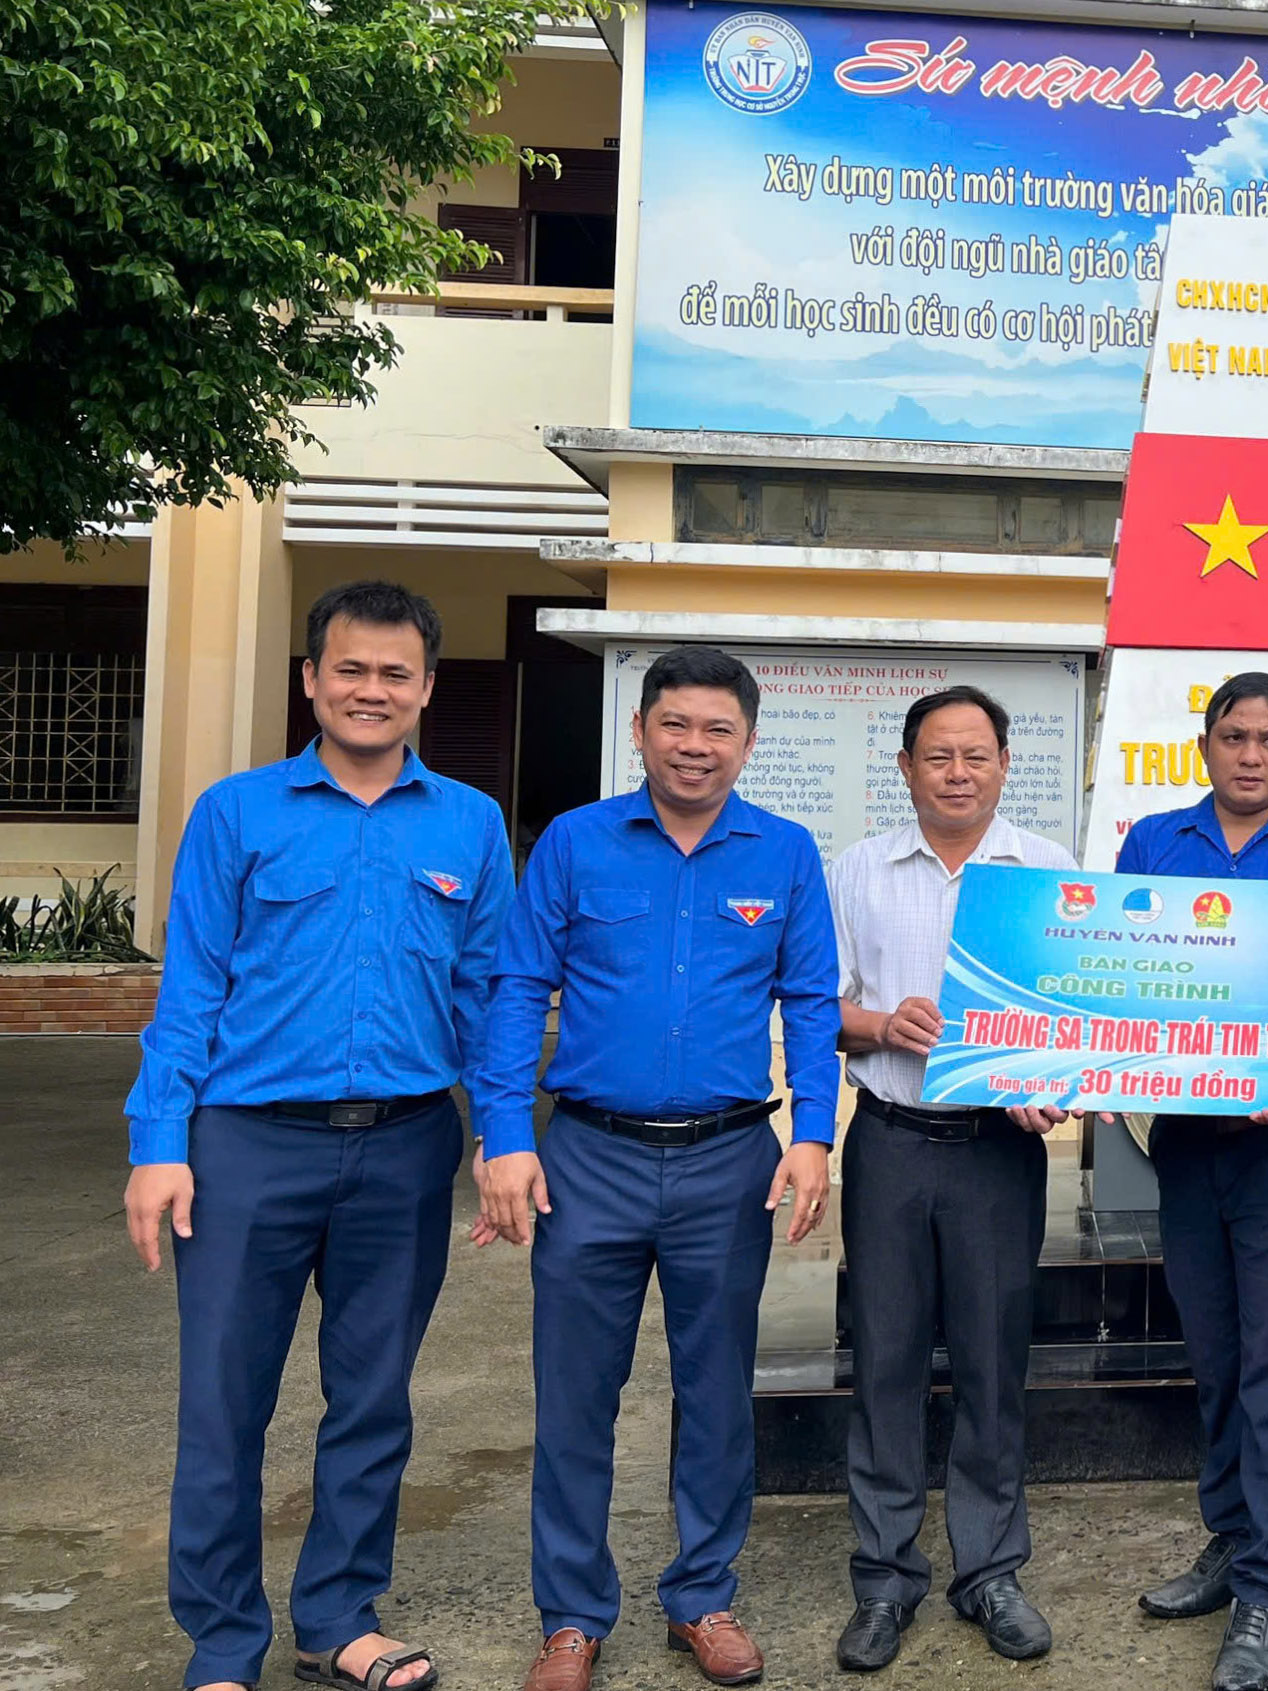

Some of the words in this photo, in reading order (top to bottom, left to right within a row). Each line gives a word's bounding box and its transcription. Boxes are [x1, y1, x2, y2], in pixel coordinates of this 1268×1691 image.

[745, 15, 760, 24] DÂN
[980, 50, 1164, 108] mệnh
[764, 154, 816, 202] Xây
[822, 156, 894, 206] dựng
[900, 163, 958, 216] một
[962, 165, 1015, 206] môi
[1021, 170, 1114, 218] trường
[1120, 180, 1168, 214] văn
[1174, 177, 1226, 216] hóa
[850, 227, 894, 266] với
[900, 228, 946, 272] đội
[951, 238, 1004, 277] ngũ
[1010, 237, 1061, 277] nhà
[1069, 239, 1128, 285] giáo
[1133, 242, 1163, 281] tâ
[680, 281, 717, 328] để
[722, 283, 777, 330] mỗi
[784, 291, 836, 339] học
[839, 294, 899, 336] sinh
[906, 294, 959, 338] đều
[965, 304, 997, 341] có
[1003, 308, 1035, 342] cơ
[1040, 302, 1084, 353] hội
[1090, 304, 1154, 353] phát
[1167, 337, 1220, 380] VIỆT
[756, 665, 770, 676] 10
[813, 663, 844, 677] VĂN
[849, 667, 886, 679] MINH
[891, 668, 925, 682] LỊCH
[928, 668, 949, 682] SỰ
[788, 684, 824, 695] GIAO
[828, 680, 862, 696] TIẾP
[866, 681, 896, 696] CỦA
[1036, 727, 1064, 739] đường
[1028, 752, 1045, 762] cha
[807, 763, 834, 775] không
[752, 789, 783, 801] trường
[781, 804, 795, 812] khi
[1183, 935, 1237, 947] NINH
[1132, 959, 1195, 975] GIAO
[1036, 973, 1126, 998] CÔNG
[1137, 976, 1231, 1001] TRÌNH
[962, 1008, 1050, 1050] TRƯỜNG
[1054, 1018, 1082, 1053] SA
[1088, 1019, 1160, 1055] TRONG
[1165, 1012, 1217, 1057] TRÁI
[1219, 1022, 1261, 1058] TIM
[1078, 1069, 1111, 1095] 30
[1120, 1070, 1182, 1103] triệu
[1190, 1070, 1257, 1103] đồng
